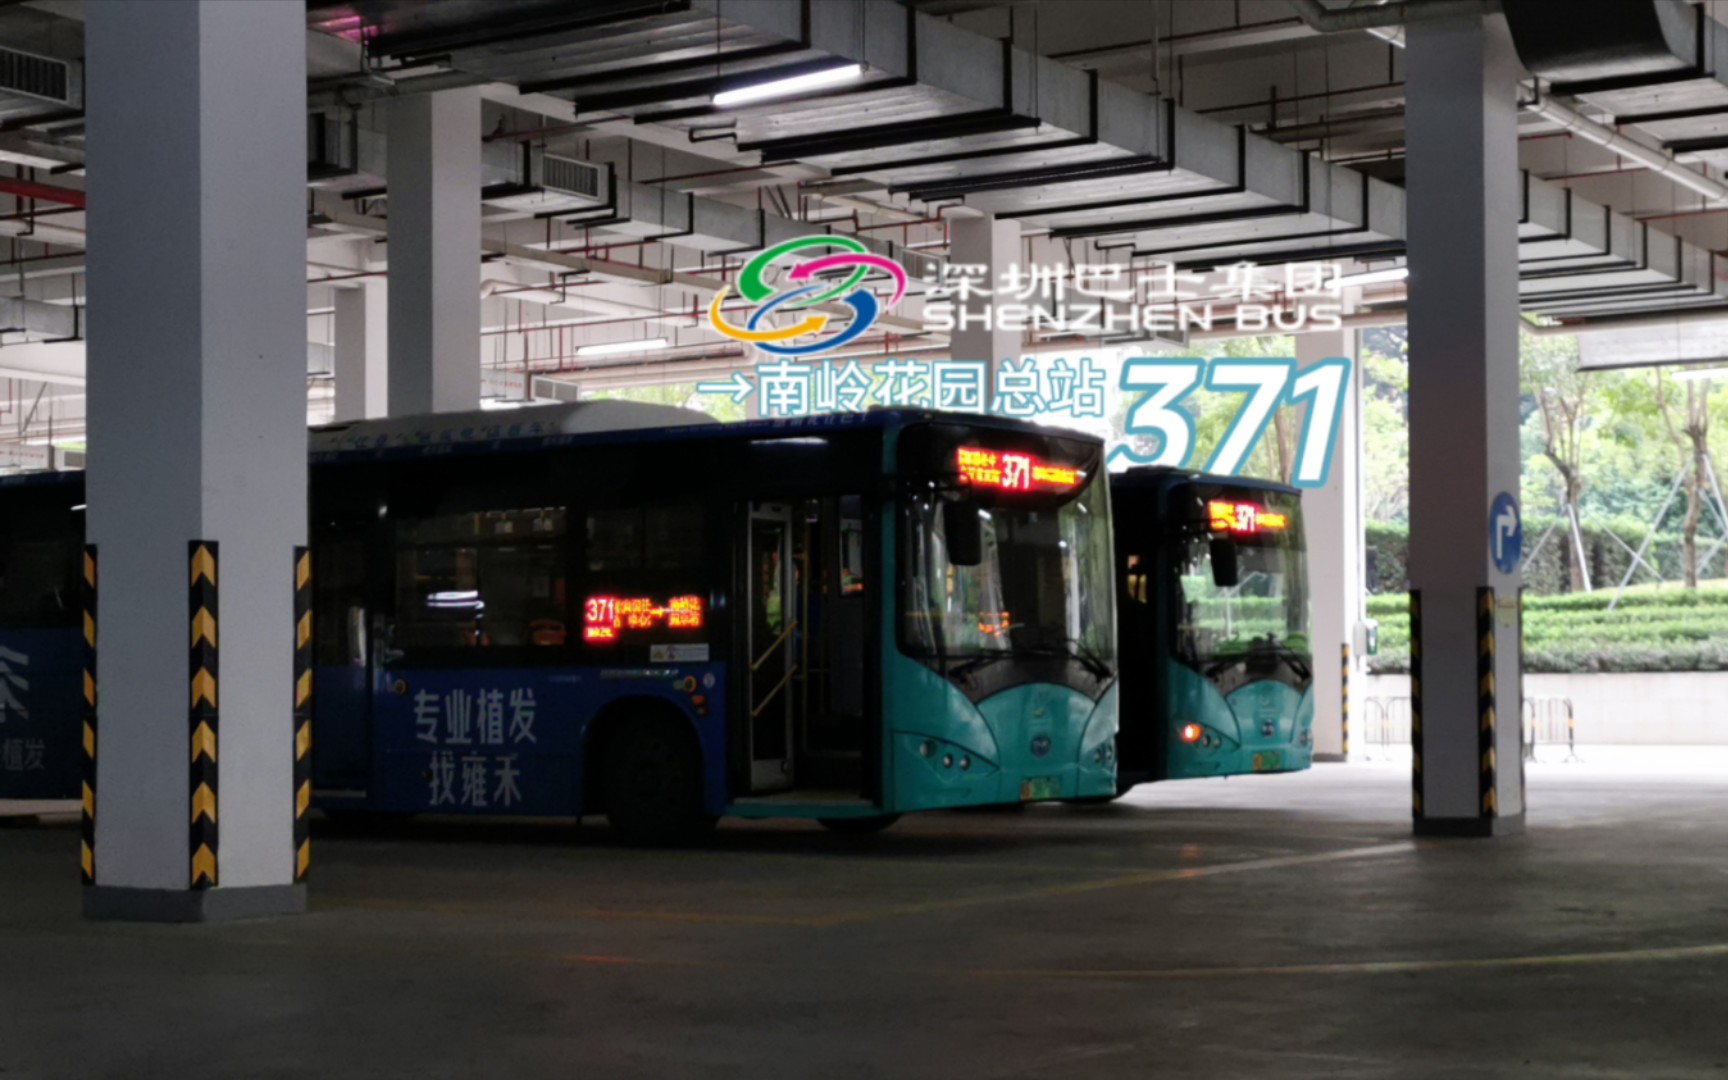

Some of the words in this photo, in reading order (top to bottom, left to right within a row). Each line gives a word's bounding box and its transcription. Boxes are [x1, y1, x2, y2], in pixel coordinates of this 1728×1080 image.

[1002, 454, 1030, 489] 371
[586, 597, 614, 622] 371
[413, 687, 537, 744] 专业植发
